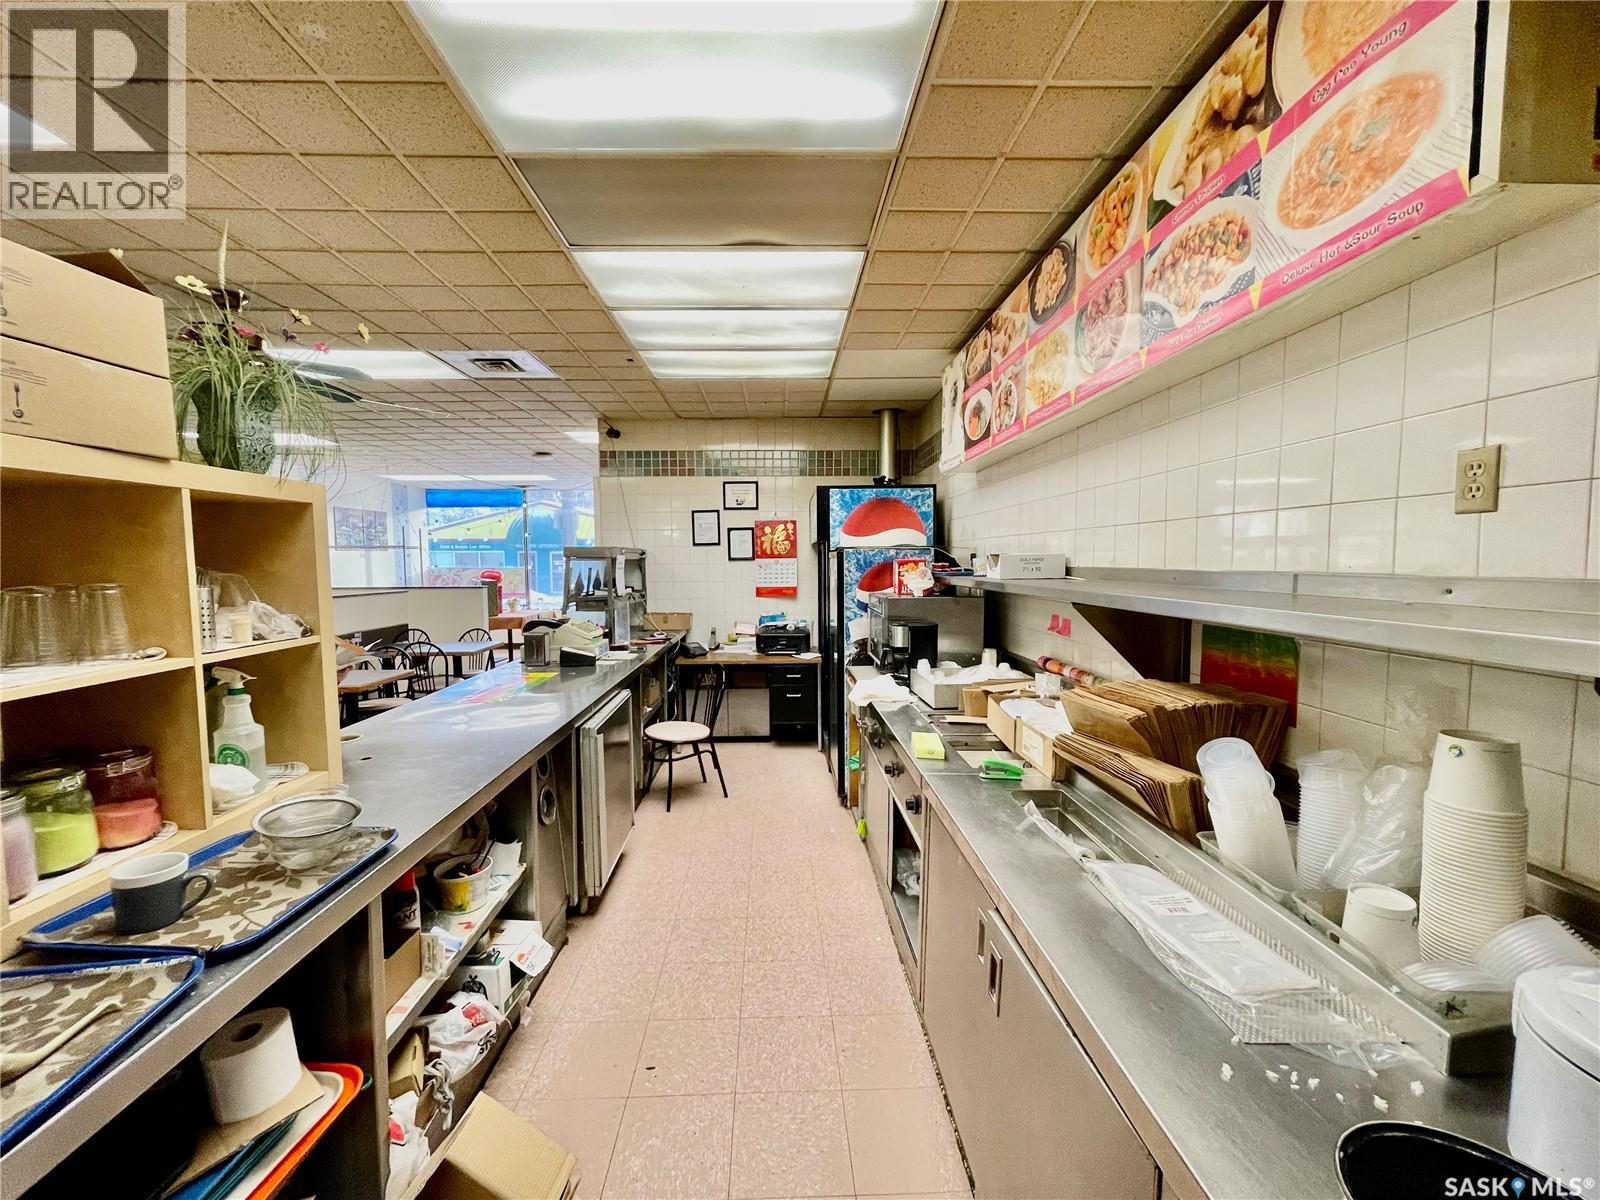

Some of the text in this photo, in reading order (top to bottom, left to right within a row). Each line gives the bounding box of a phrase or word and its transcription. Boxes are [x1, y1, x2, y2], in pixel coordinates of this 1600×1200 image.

[1312, 83, 1331, 102] Egg
[1361, 21, 1407, 58] Young
[1281, 260, 1316, 285] Deluxe
[1319, 246, 1341, 263] Hot
[1387, 201, 1424, 226] Soup
